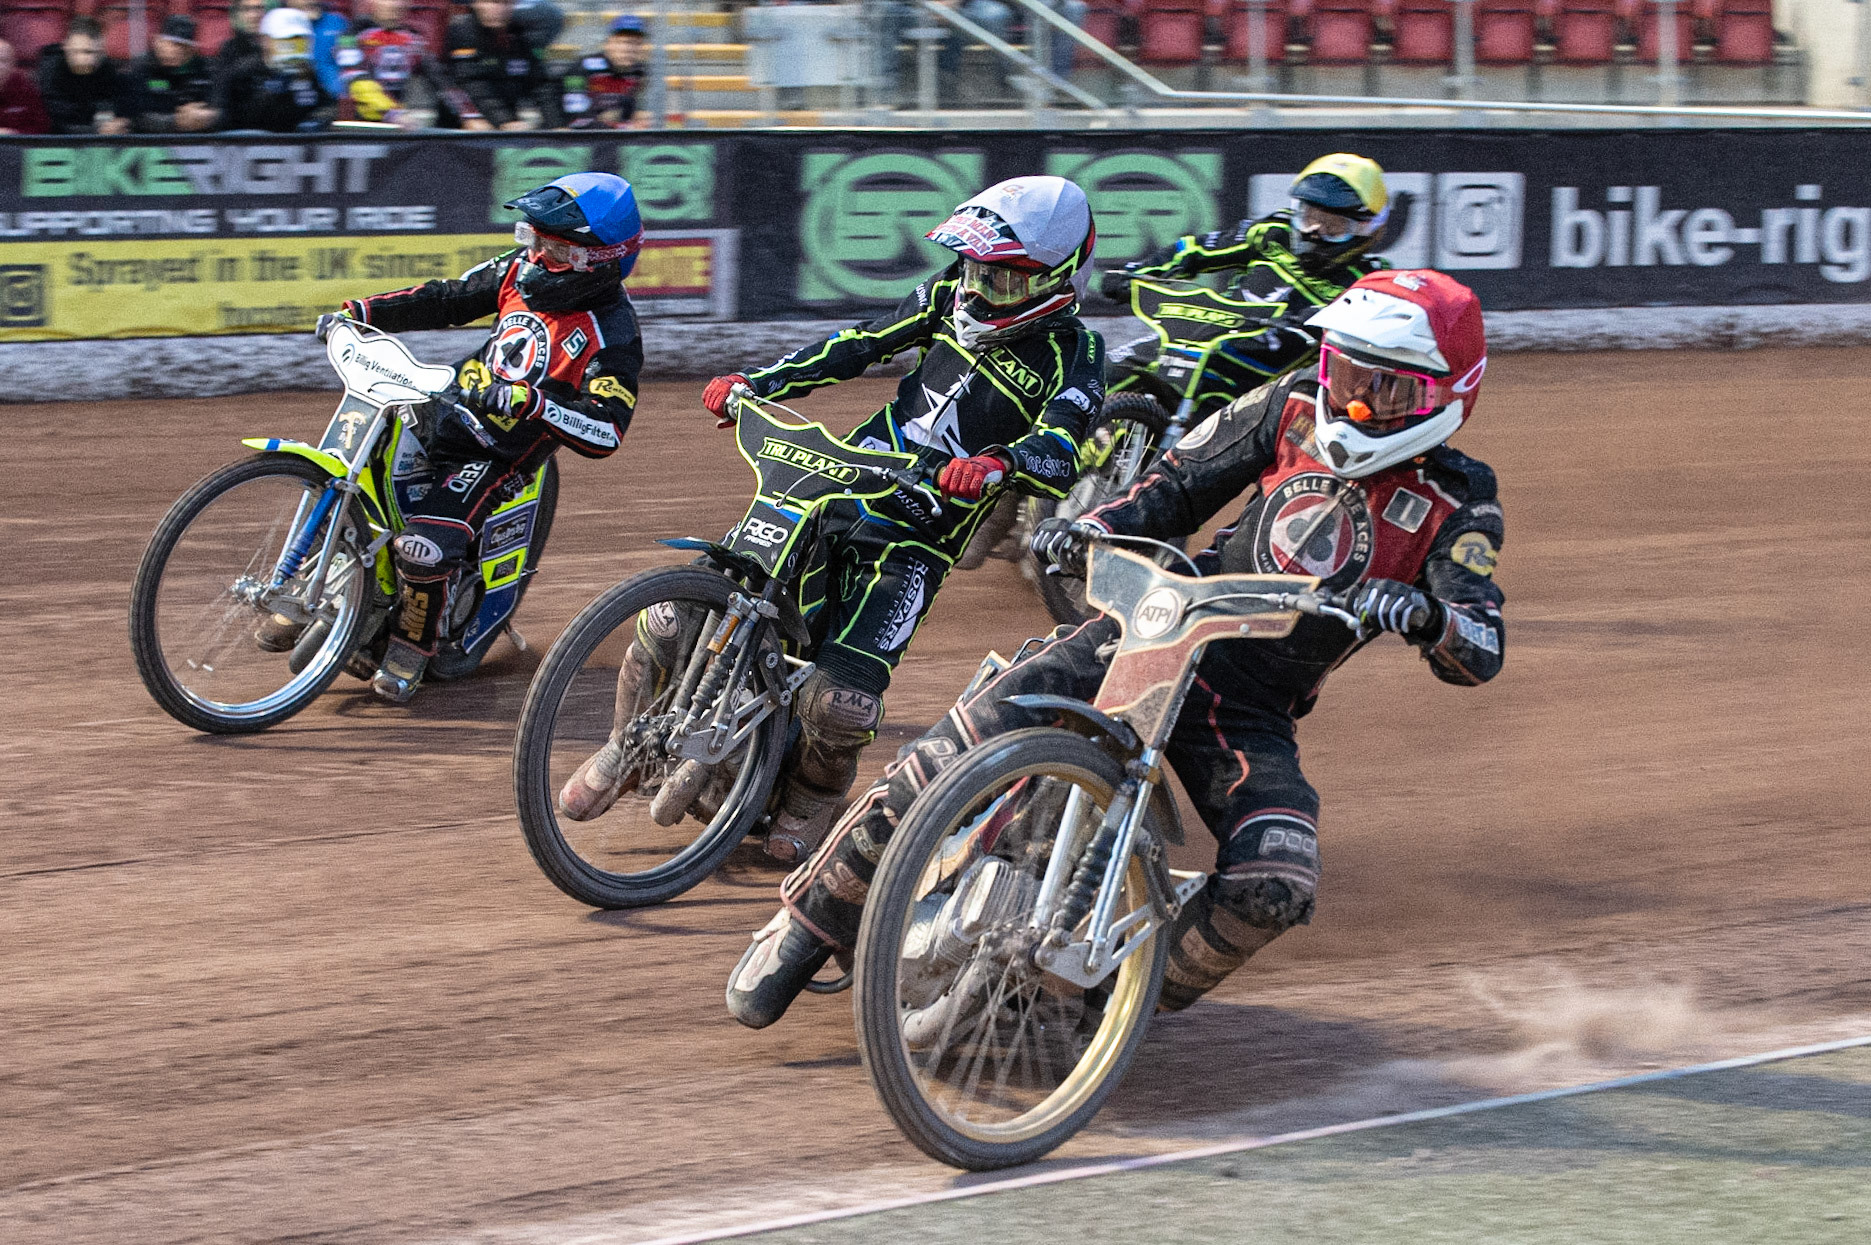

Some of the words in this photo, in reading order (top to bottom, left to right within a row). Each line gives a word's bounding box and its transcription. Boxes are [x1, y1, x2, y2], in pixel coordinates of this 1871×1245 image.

[22, 144, 391, 197] BIKERIGHT
[502, 315, 529, 330] BELLE
[534, 341, 547, 368] ACES
[566, 331, 584, 352] 5
[764, 441, 793, 461] TRU
[792, 450, 854, 481] PLANT
[1282, 478, 1331, 499] BELLE
[1352, 521, 1370, 563] ACES
[402, 540, 431, 559] GM
[1137, 605, 1173, 624] ATPI
